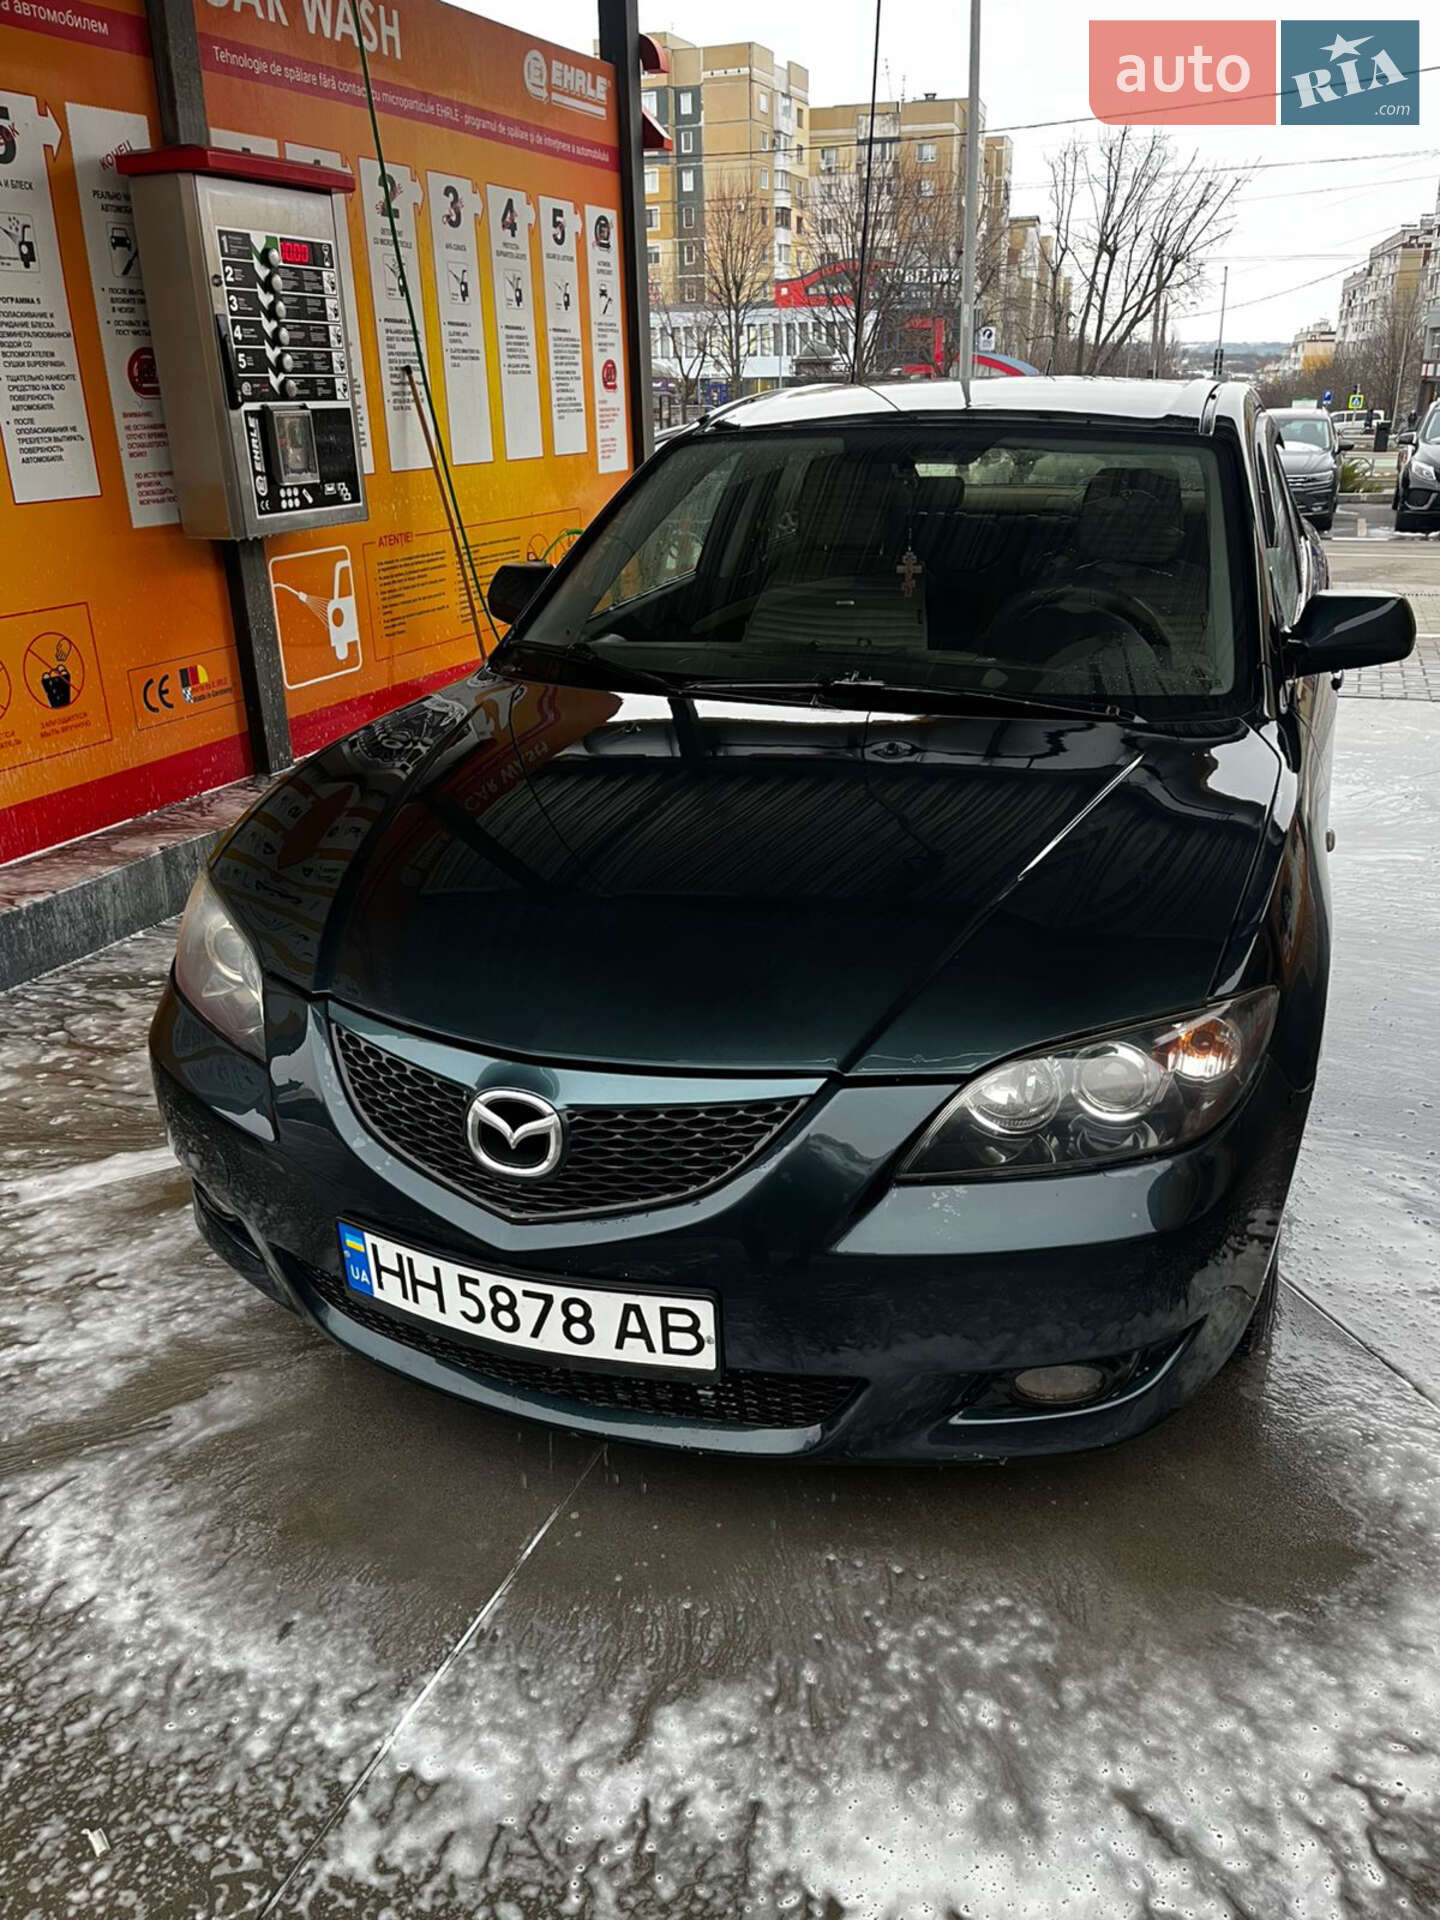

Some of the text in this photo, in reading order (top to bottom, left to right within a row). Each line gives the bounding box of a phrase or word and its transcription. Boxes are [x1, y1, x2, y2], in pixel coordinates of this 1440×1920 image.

[13, 1, 109, 35] автомобилем
[303, 0, 401, 60] WASH
[213, 46, 268, 73] Tehnologie
[270, 61, 282, 76] de
[552, 60, 607, 104] EHRLE
[378, 174, 400, 219] 2
[443, 185, 463, 228] 3
[501, 197, 518, 238] 4
[551, 207, 566, 246] 5
[221, 235, 229, 253] 1
[224, 265, 235, 282] 2
[228, 295, 238, 311] 3
[233, 325, 243, 341] 4
[238, 353, 247, 370] 5
[350, 1264, 370, 1283] UA
[371, 1243, 705, 1356] HH 5878 AB
